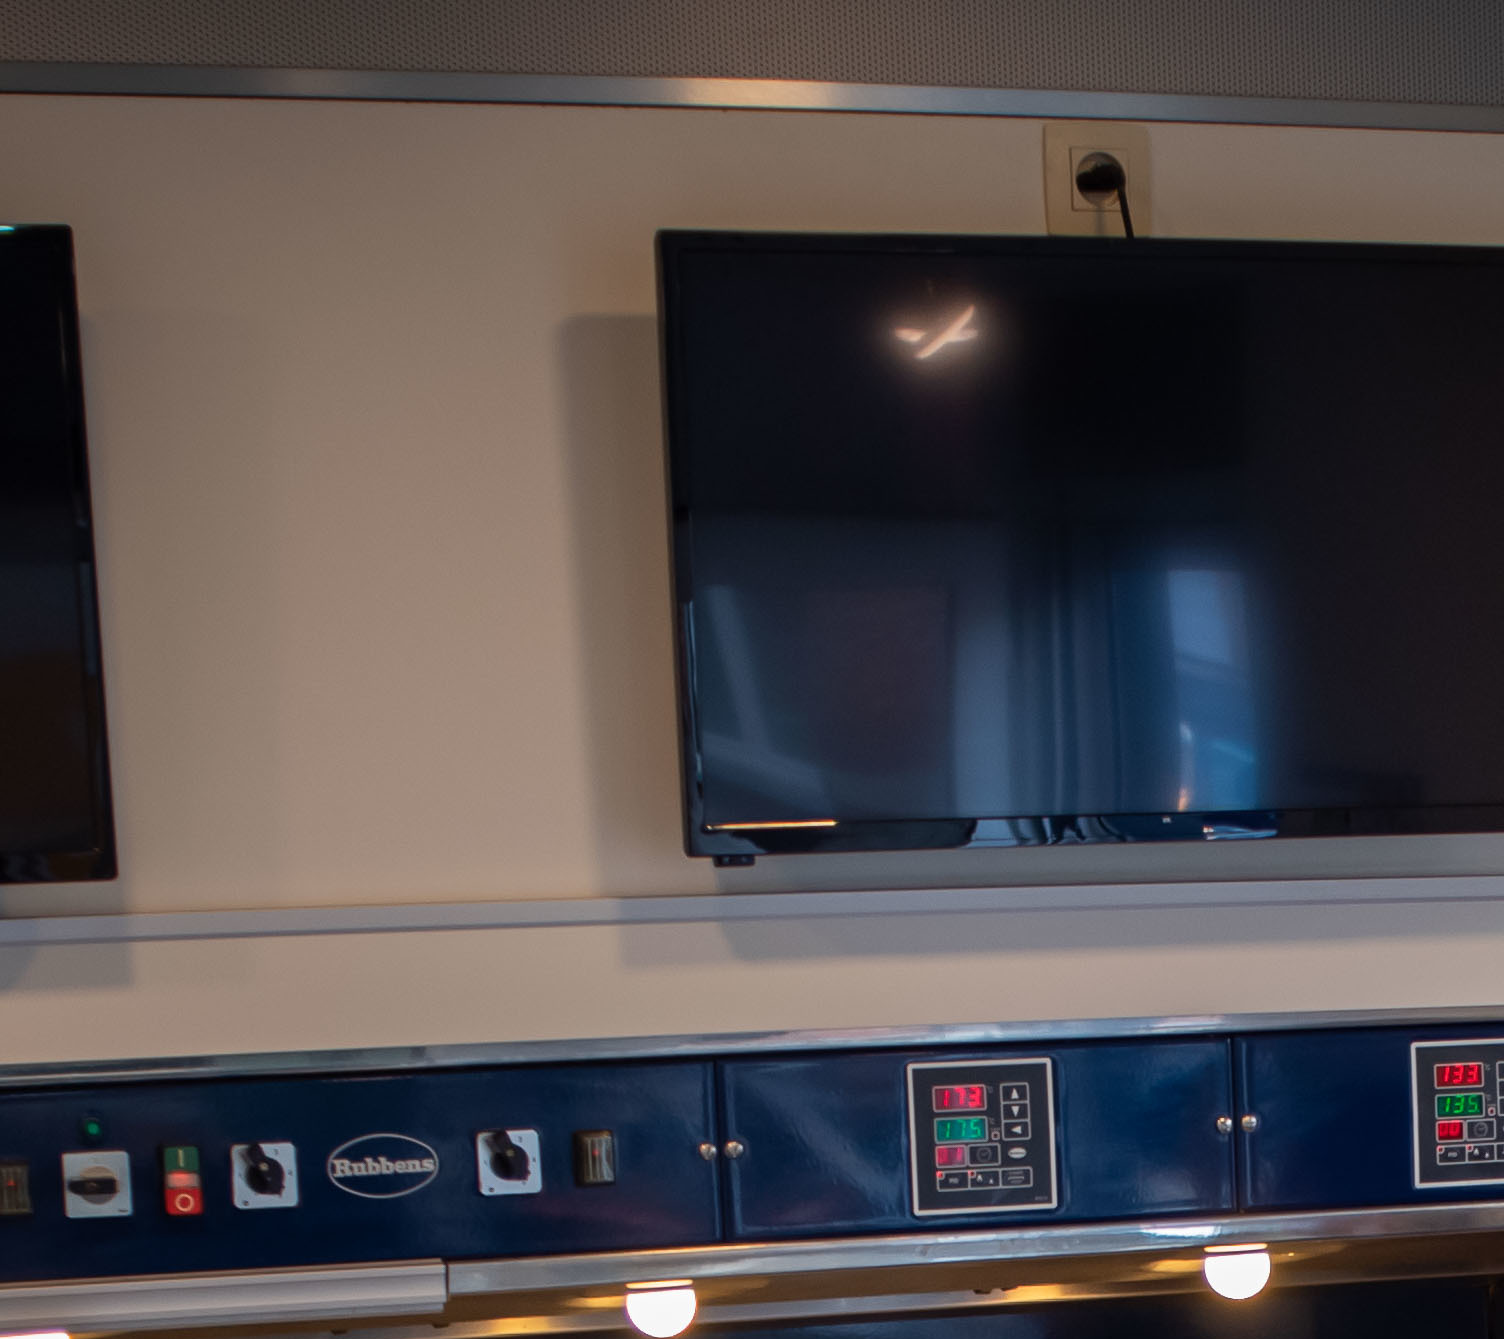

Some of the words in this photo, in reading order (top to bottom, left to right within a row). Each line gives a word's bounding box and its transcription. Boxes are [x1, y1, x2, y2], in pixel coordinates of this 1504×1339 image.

[1443, 1063, 1480, 1085] 133
[943, 1086, 984, 1108] 173
[1445, 1094, 1481, 1114] 135
[946, 1117, 982, 1139] 175
[333, 1156, 436, 1178] Rubbens
